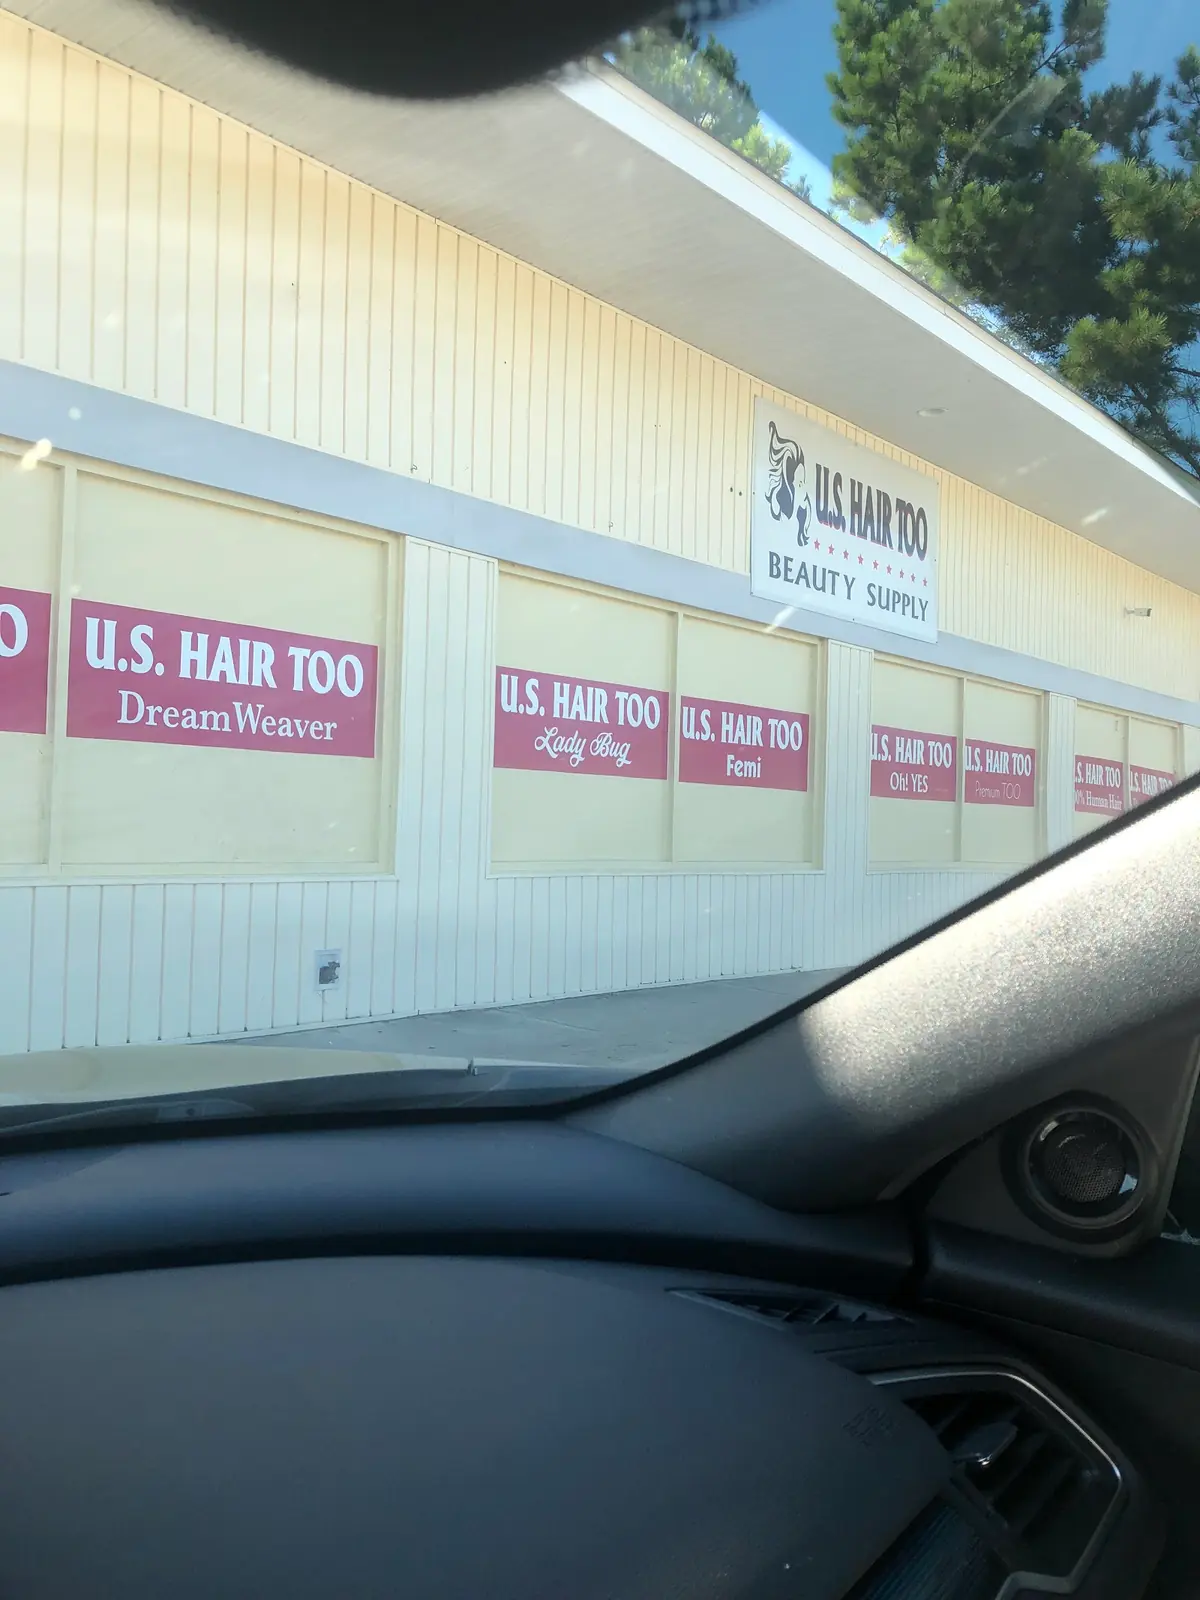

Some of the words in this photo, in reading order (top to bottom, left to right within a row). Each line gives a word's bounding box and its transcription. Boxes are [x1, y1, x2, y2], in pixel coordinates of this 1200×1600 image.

[815, 462, 847, 533] U.S.
[850, 478, 893, 550] HAIR
[896, 497, 928, 561] TOO
[769, 551, 856, 600] BEAUTY
[867, 582, 928, 622] SUPPLY
[85, 616, 165, 676] U.S.
[178, 630, 277, 688] HAIR
[288, 646, 364, 697] TOO
[500, 673, 545, 717] U.S.
[553, 681, 610, 725] HAIR
[615, 691, 660, 729] TOO
[534, 726, 587, 767] Lady
[589, 732, 632, 767] Bug
[682, 706, 715, 742] U.S.
[721, 711, 763, 747] HAIR
[768, 718, 803, 751] TOO
[726, 754, 761, 778] Femi
[895, 736, 925, 765] HAIR
[928, 741, 952, 768] TOO
[985, 748, 1009, 774] HAIR
[1012, 752, 1031, 776] TOO
[890, 772, 908, 791] Oh!
[911, 773, 928, 793] YES
[1001, 782, 1021, 799] TOO
[1085, 762, 1104, 786] HAIR
[1105, 766, 1121, 788] TOO
